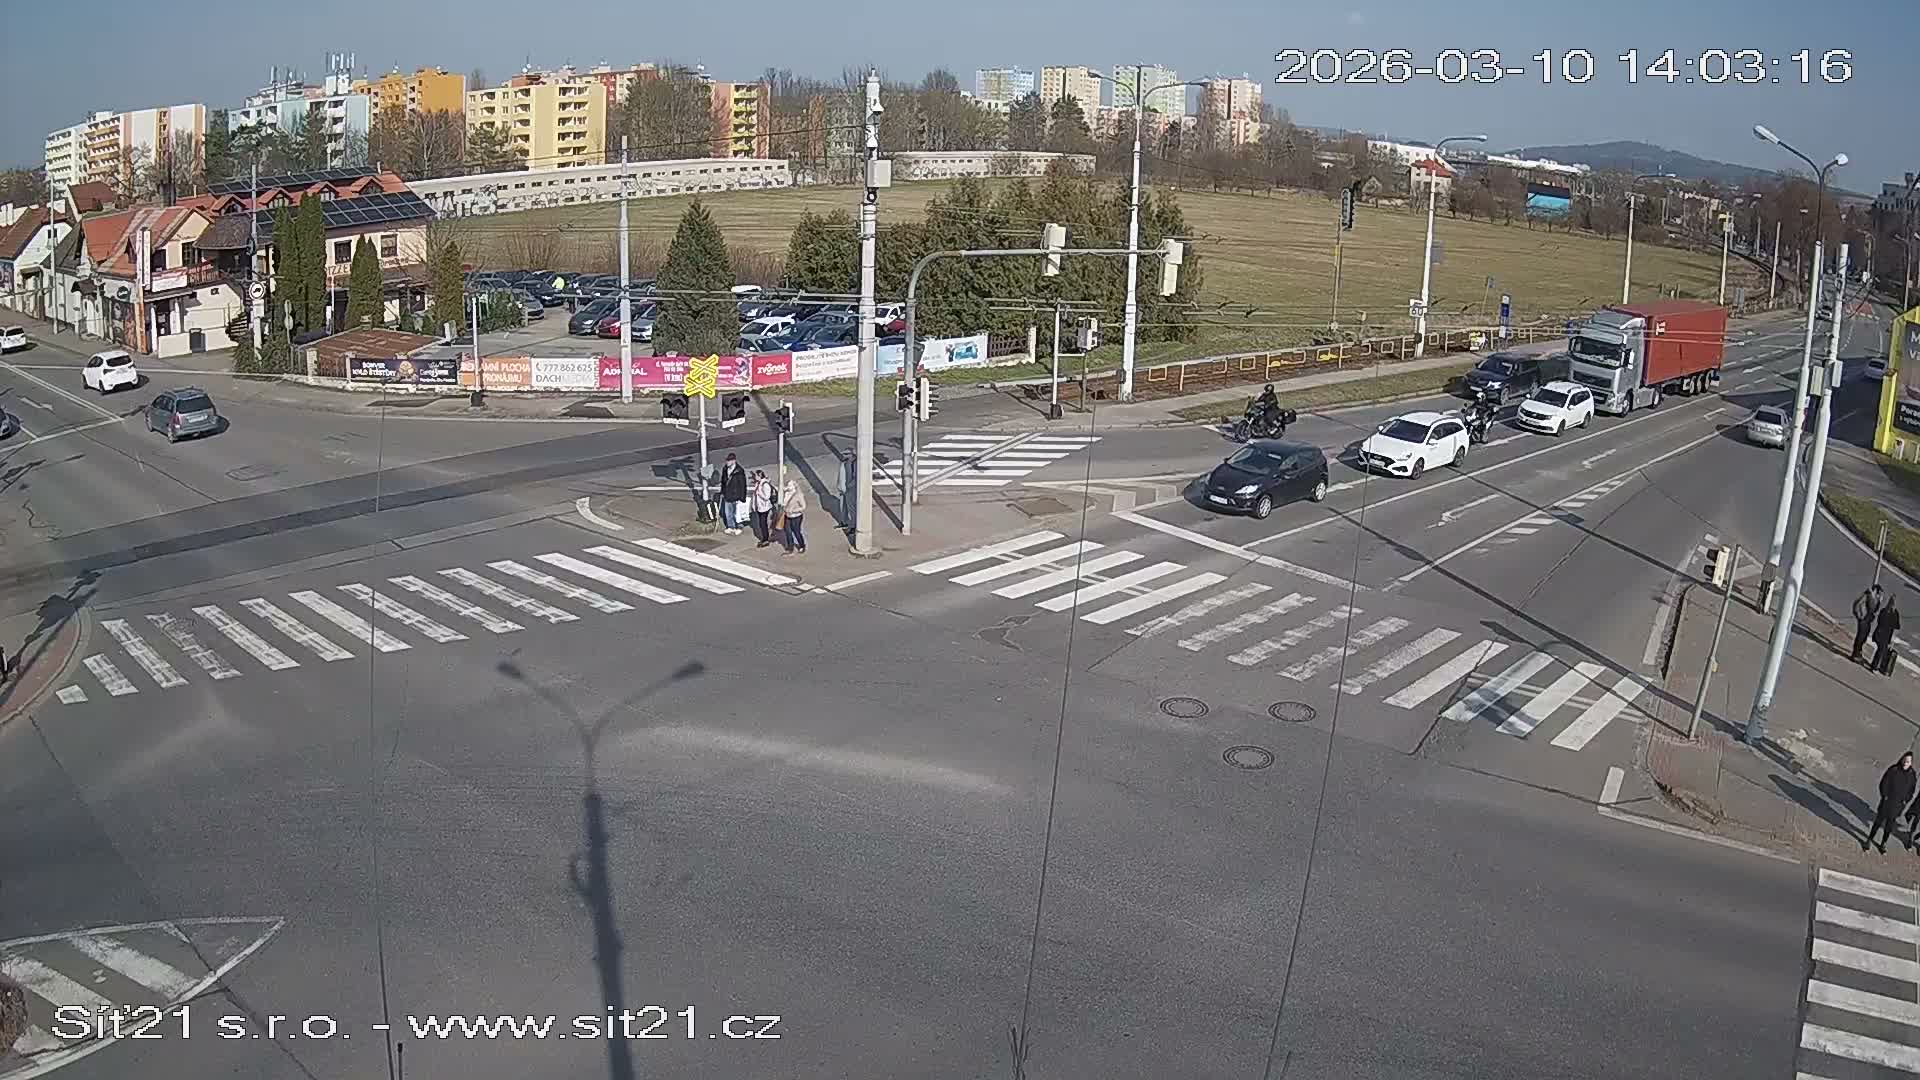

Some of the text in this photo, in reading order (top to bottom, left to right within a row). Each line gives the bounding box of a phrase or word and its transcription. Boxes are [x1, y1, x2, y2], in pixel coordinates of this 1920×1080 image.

[543, 364, 561, 374] 777
[561, 363, 576, 374] 862
[602, 367, 648, 377] ADMAL
